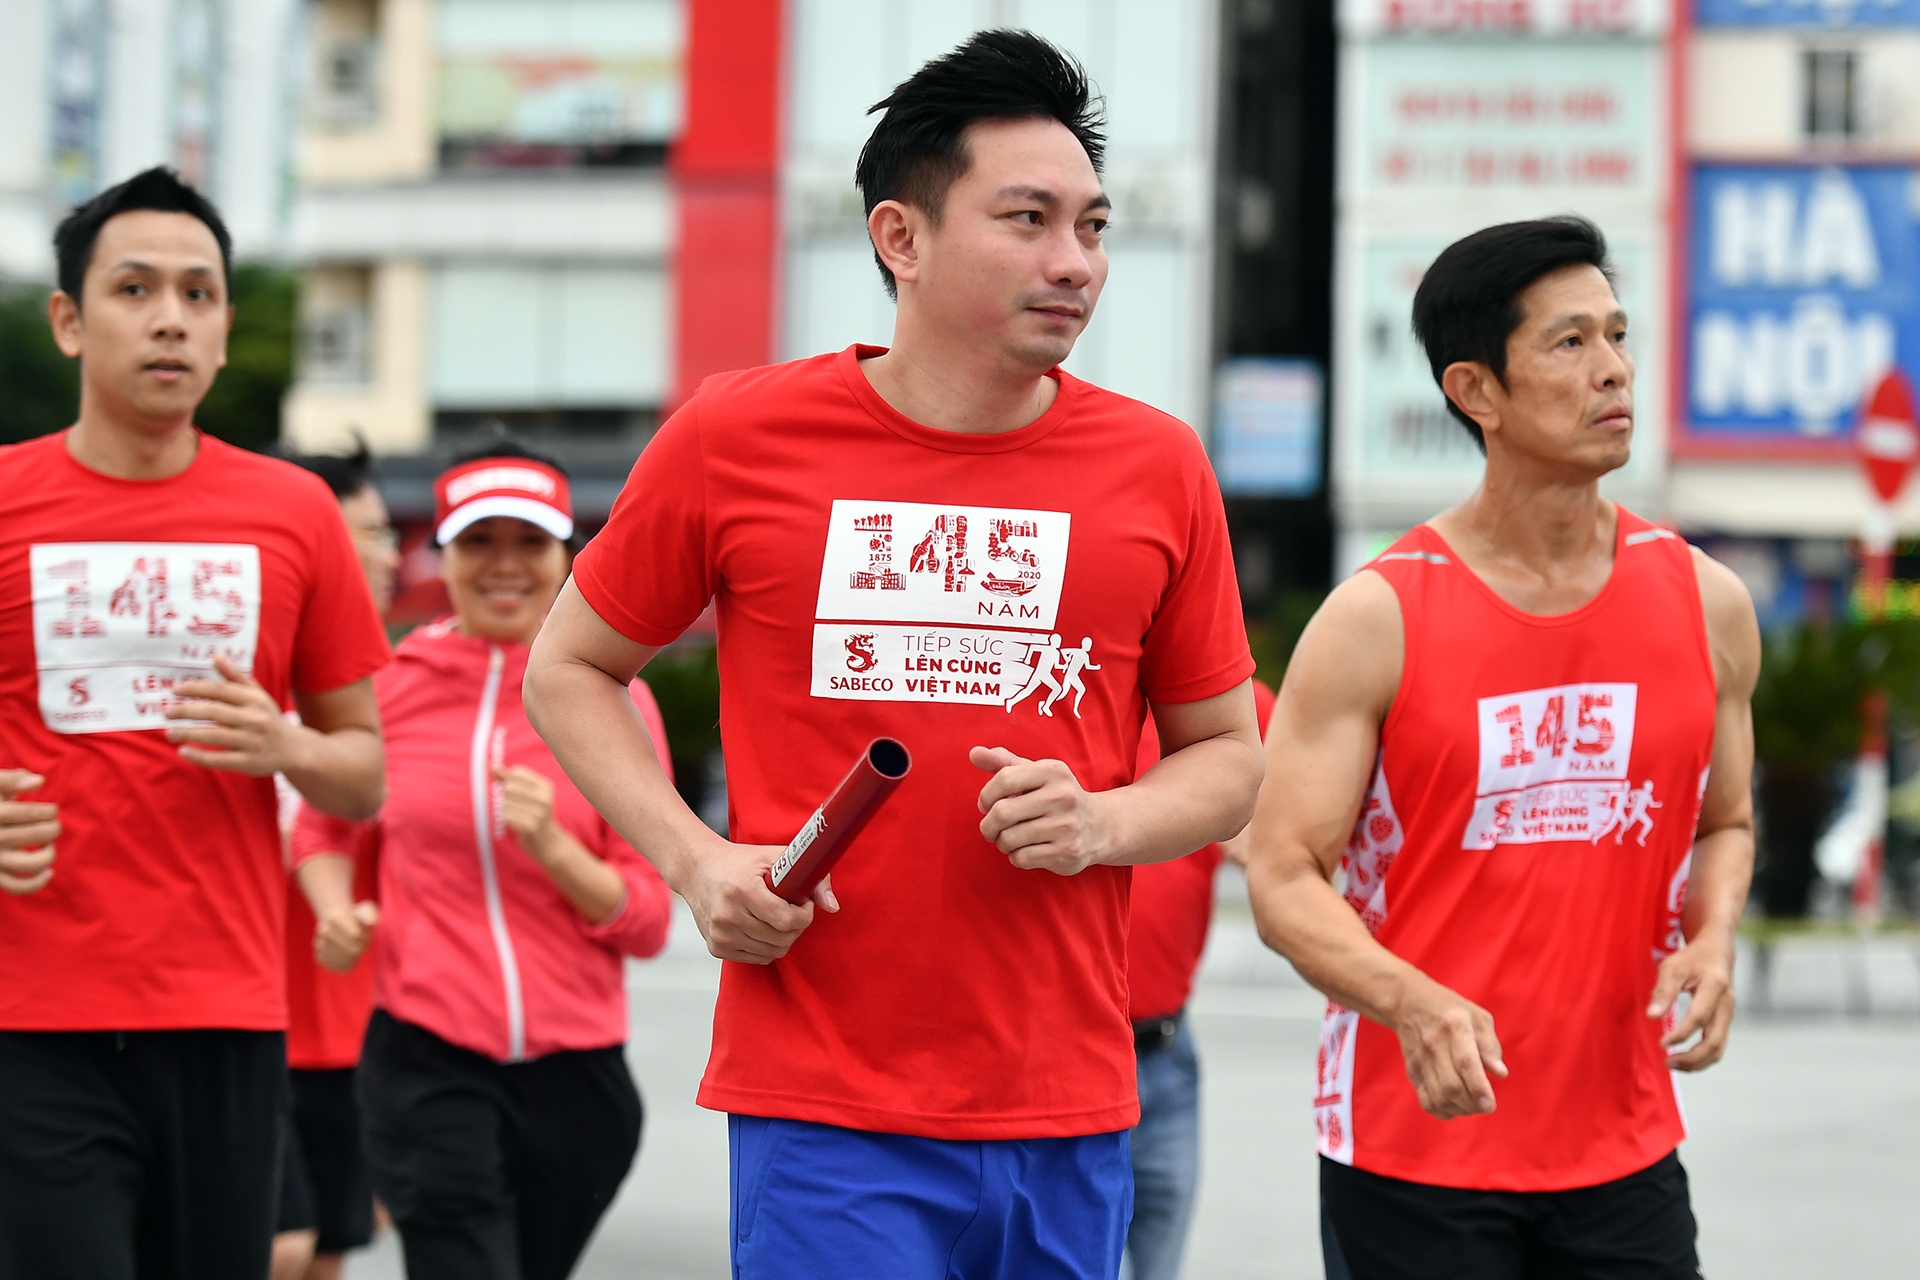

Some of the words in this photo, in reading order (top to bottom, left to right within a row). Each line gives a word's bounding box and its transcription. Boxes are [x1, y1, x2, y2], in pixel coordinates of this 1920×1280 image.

[850, 513, 1041, 598] 145
[869, 553, 892, 562] 1875
[1018, 570, 1041, 580] 2020
[48, 558, 246, 638] 145
[977, 600, 1040, 619] NĂM
[902, 631, 951, 652] TIẾP
[959, 635, 1004, 656] SỨC
[904, 654, 943, 672] LÊN
[947, 656, 1002, 675] CÙNG
[829, 676, 894, 692] SABECO
[905, 676, 951, 698] VIỆT
[955, 681, 1001, 696] NAM
[1495, 694, 1616, 770] 145
[1569, 760, 1616, 773] NĂM
[1522, 807, 1549, 820] LÊN
[1555, 823, 1589, 833] NAM
[774, 853, 787, 878] 145
